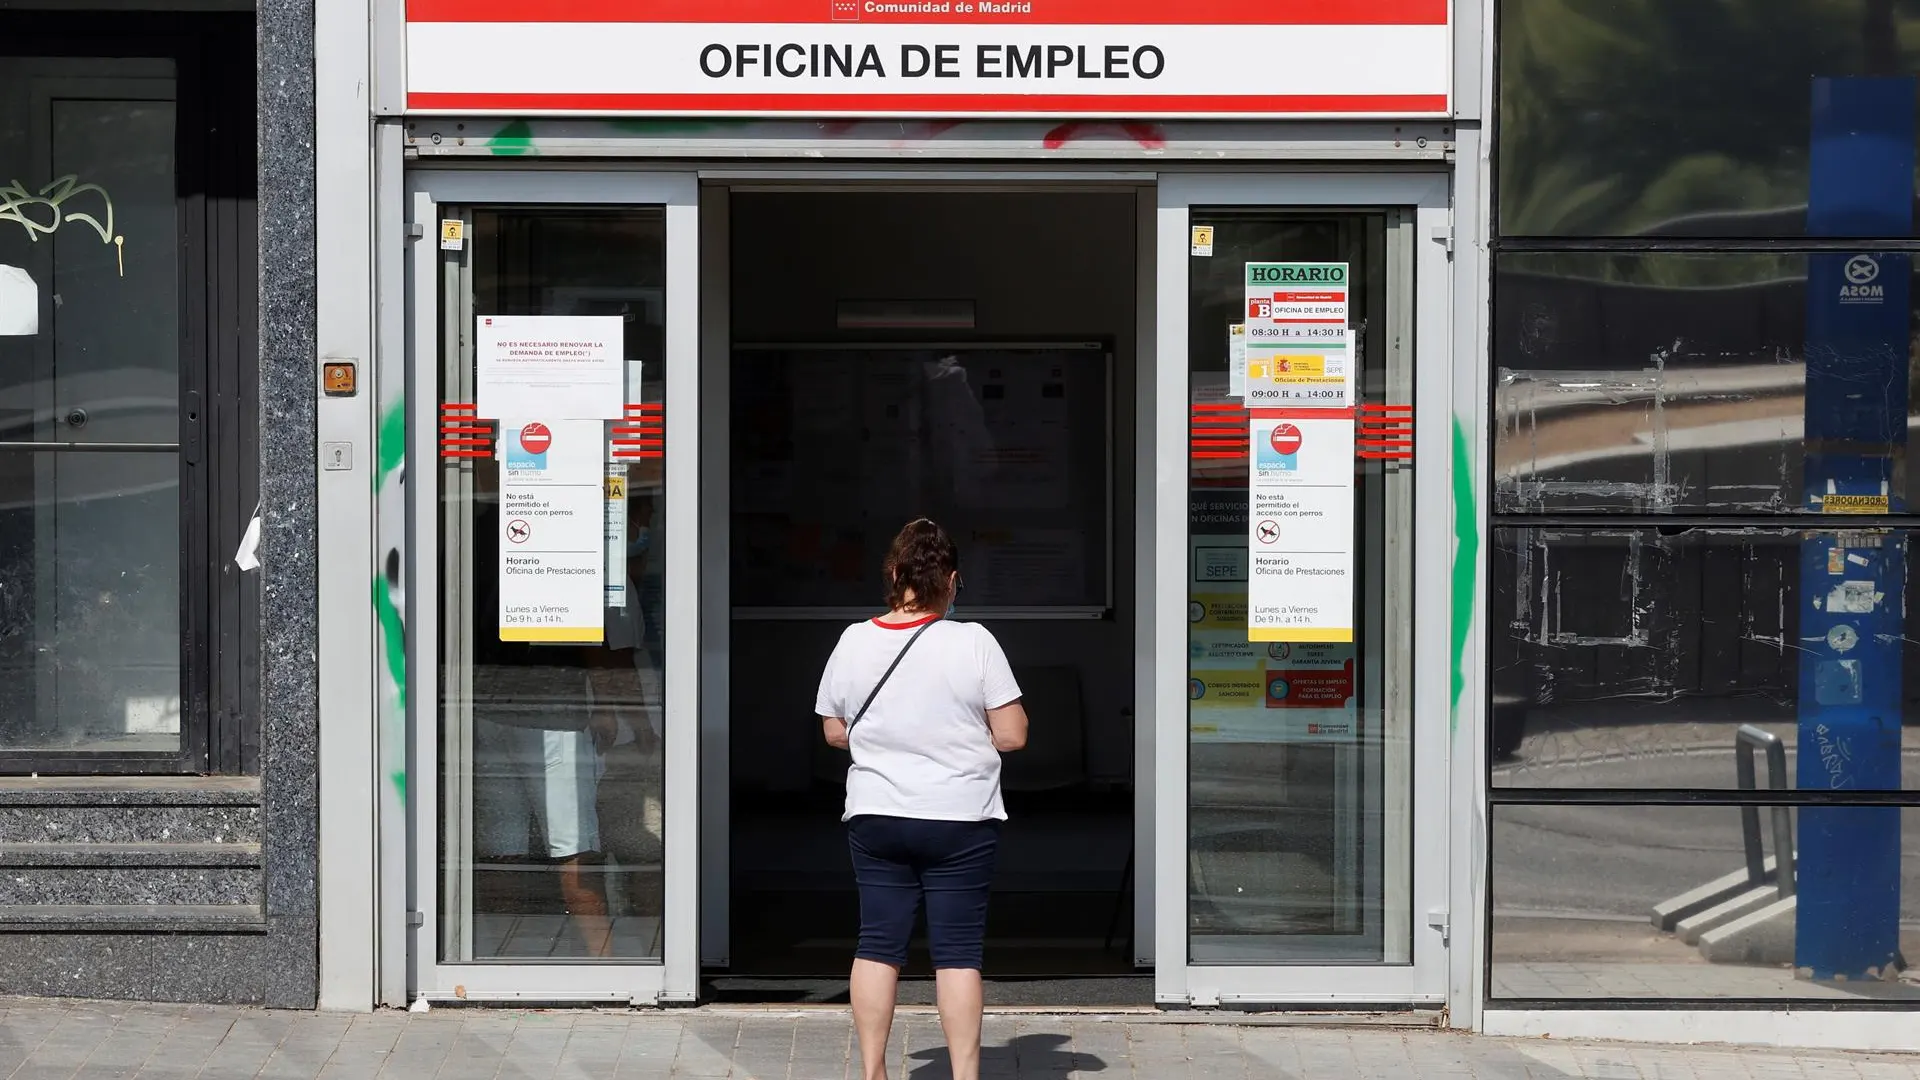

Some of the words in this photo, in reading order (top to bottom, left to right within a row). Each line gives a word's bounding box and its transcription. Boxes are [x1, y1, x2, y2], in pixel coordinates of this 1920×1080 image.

[864, 1, 950, 14] Comunidad
[953, 1, 972, 14] de
[978, 1, 1032, 14] Madrid
[699, 43, 886, 78] OFICINA
[901, 44, 961, 78] DE
[977, 45, 1165, 80] EMPLEO
[1252, 267, 1344, 282] HORARIO
[1258, 304, 1270, 317] B
[1261, 365, 1268, 377] 1
[508, 461, 536, 470] espacio
[1259, 461, 1285, 470] espacio
[1206, 566, 1237, 576] SEPE
[1256, 568, 1282, 576] Oficina
[1284, 568, 1294, 576] de
[1296, 568, 1345, 576] Prestaciones
